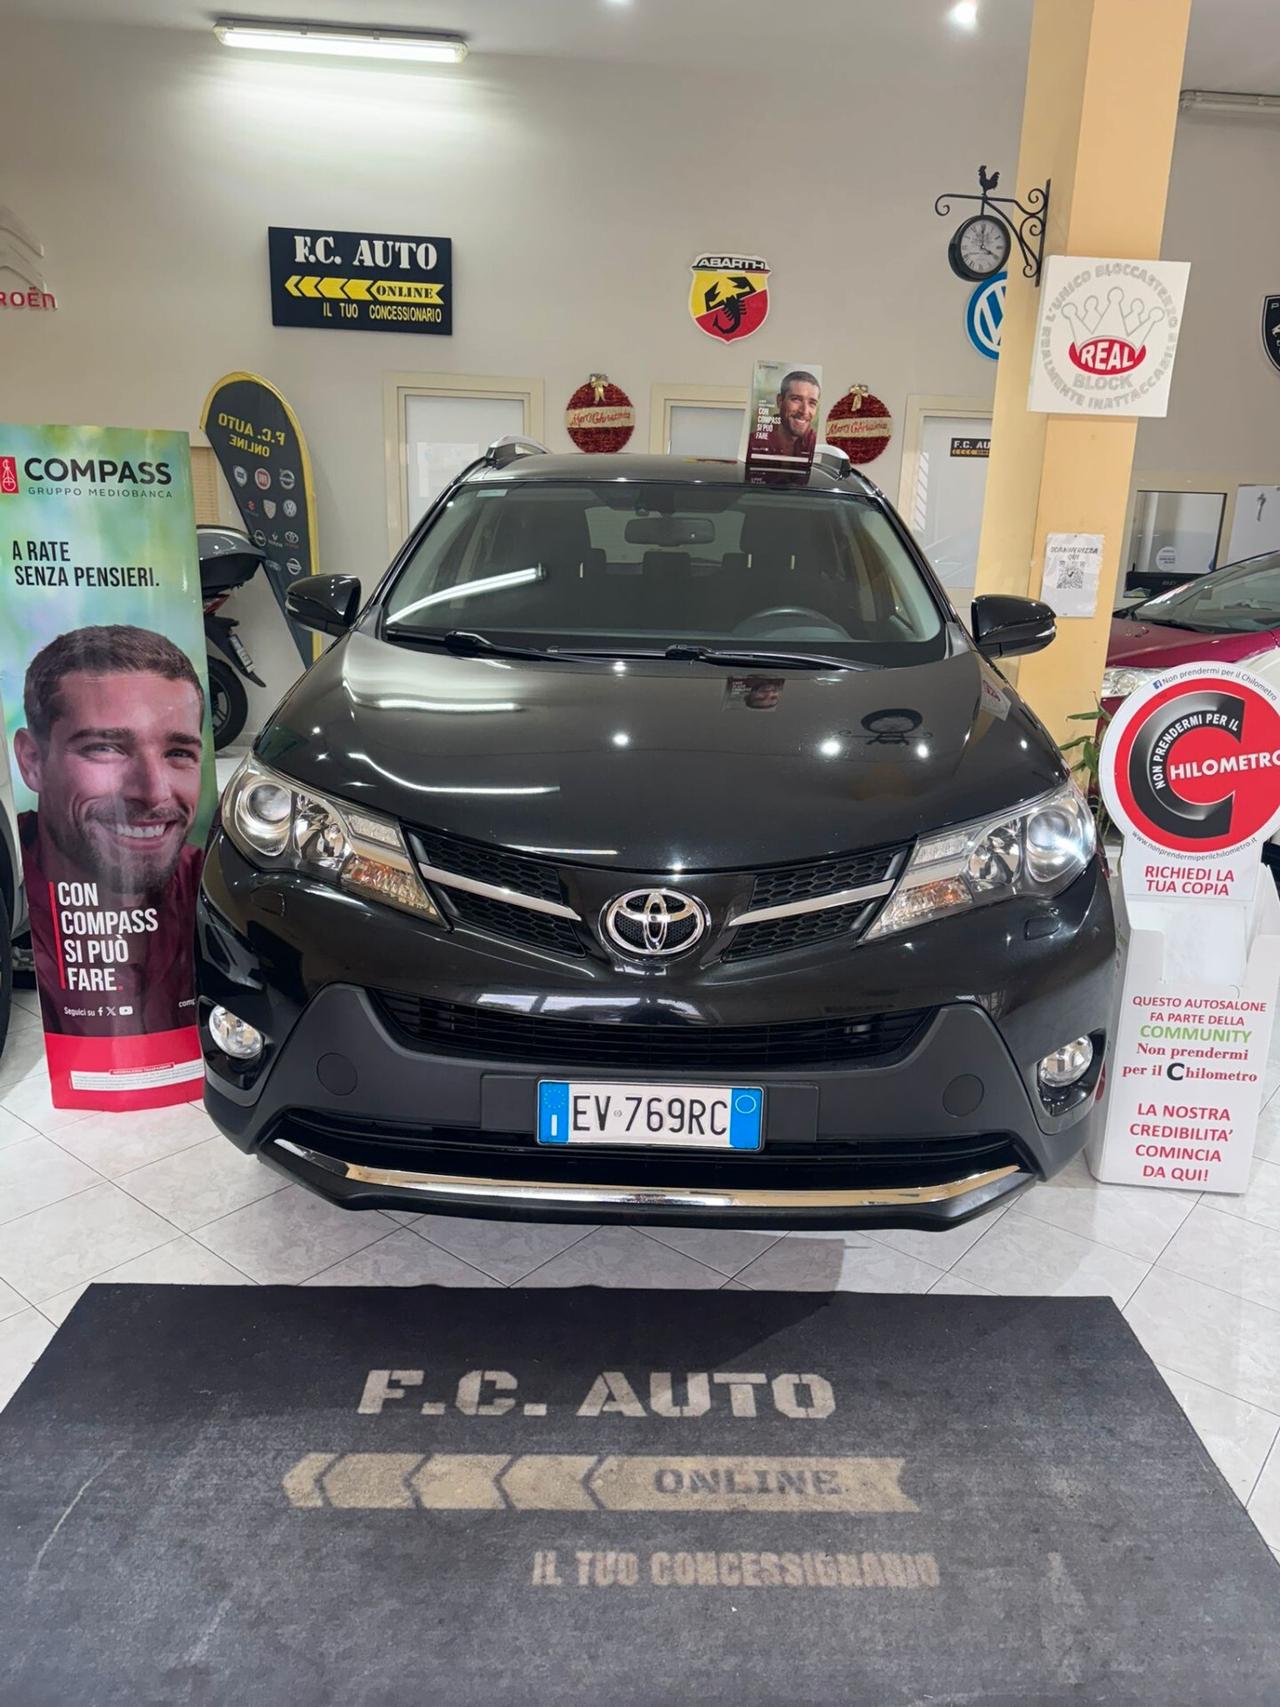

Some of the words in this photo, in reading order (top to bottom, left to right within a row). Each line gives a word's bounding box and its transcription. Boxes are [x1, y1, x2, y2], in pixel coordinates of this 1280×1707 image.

[294, 235, 342, 265] F.C.
[353, 239, 438, 270] AUTO
[699, 258, 765, 269] ABARTH
[376, 285, 434, 299] ONLINE
[323, 303, 332, 317] IL
[339, 303, 359, 319] TUO
[369, 305, 442, 323] CONCESSIONARIO
[1080, 342, 1134, 370] REAL
[1072, 373, 1134, 391] BLOCK
[954, 440, 973, 449] F.C.
[24, 457, 172, 485] COMPASS
[28, 487, 82, 496] GRUPPO
[89, 488, 173, 498] MEDIOBANCA
[12, 540, 23, 561] A
[27, 541, 71, 562] RATE
[14, 566, 69, 587] SENZA
[74, 567, 160, 587] PENSIERI.
[1162, 675, 1179, 685] Non
[1179, 667, 1220, 680] prendermi
[1221, 669, 1235, 678] per
[1241, 674, 1277, 701] Chilometro
[1206, 713, 1227, 725] PER
[1228, 718, 1240, 732] IL
[1153, 714, 1203, 761] PRENDERMI
[1152, 765, 1166, 790] NON
[1145, 865, 1212, 881] RICHIEDI
[1216, 869, 1235, 882] LA
[57, 882, 98, 907] CON
[1146, 879, 1177, 893] TUA
[1181, 881, 1229, 896] COPIA
[61, 908, 159, 935] COMPASS
[64, 939, 83, 963] SI
[88, 934, 129, 963] PUÒ
[64, 1006, 86, 1017] Seguici
[1132, 996, 1182, 1008] QUESTO
[1184, 999, 1267, 1012] AUTOSALONE
[1149, 1012, 1164, 1022] FA
[1167, 1013, 1205, 1024] PARTE
[1208, 1015, 1245, 1026] DELLA
[1139, 1025, 1252, 1043] COMMUNITY
[1136, 1042, 1166, 1056] Non
[1170, 1047, 1248, 1061] prendermi
[1122, 1065, 1147, 1077] per
[1151, 1065, 1162, 1076] il
[1166, 1062, 1258, 1082] Chilometro
[1137, 1103, 1157, 1116] LA
[1163, 1105, 1231, 1121] NOSTRA
[1129, 1123, 1233, 1142] CREDIBILITA'
[1135, 1144, 1222, 1162] COMINCIA
[1143, 1165, 1166, 1178] DA
[1171, 1167, 1209, 1182] QUI!
[357, 1368, 547, 1417] F.C.
[576, 1371, 837, 1419] AUTO
[653, 1468, 842, 1497] ONLINE
[532, 1551, 562, 1586] IL
[576, 1551, 639, 1587] TUO
